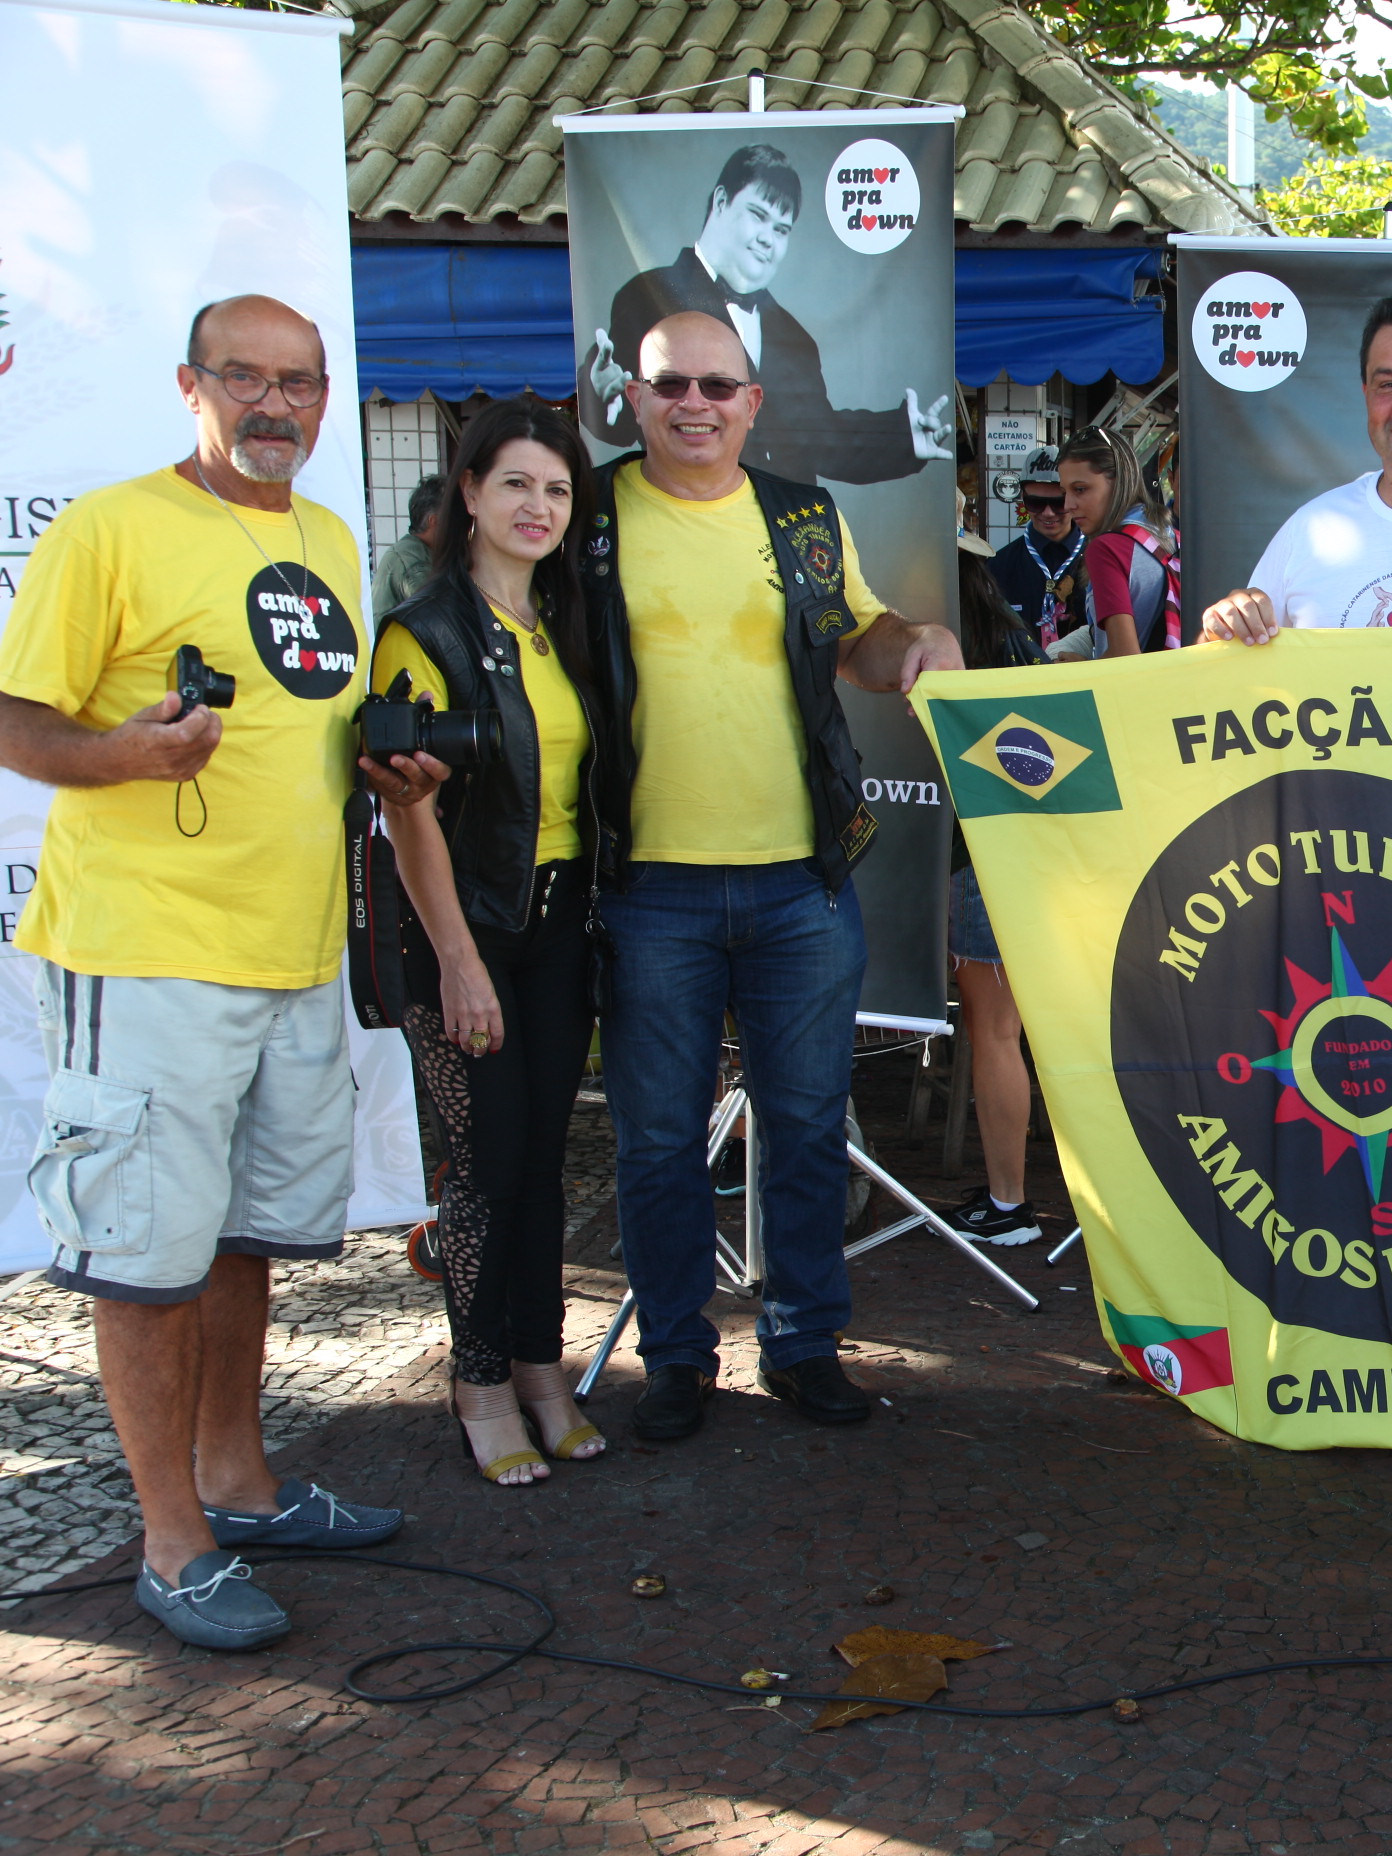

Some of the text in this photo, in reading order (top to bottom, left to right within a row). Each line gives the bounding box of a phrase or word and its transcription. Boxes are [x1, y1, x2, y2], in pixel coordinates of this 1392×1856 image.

[842, 189, 882, 212] pra
[1212, 323, 1262, 346] pra
[1001, 420, 1019, 428] NÃO
[988, 432, 1033, 440] ACEITAMOS
[994, 443, 1027, 451] CARTÃO
[1347, 578, 1381, 609] CATARINENSE
[270, 617, 320, 645] pra
[1020, 748, 1053, 764] PROGRESSO
[353, 834, 366, 929] EOS DIGITAL
[1159, 843, 1281, 983] MOTO
[1321, 890, 1355, 926] N
[1324, 1039, 1392, 1054] FUNDADO
[1217, 1052, 1252, 1084] O
[1349, 1058, 1371, 1071] EM
[1340, 1078, 1387, 1097] 2010
[1177, 1113, 1377, 1289] AMIGOS
